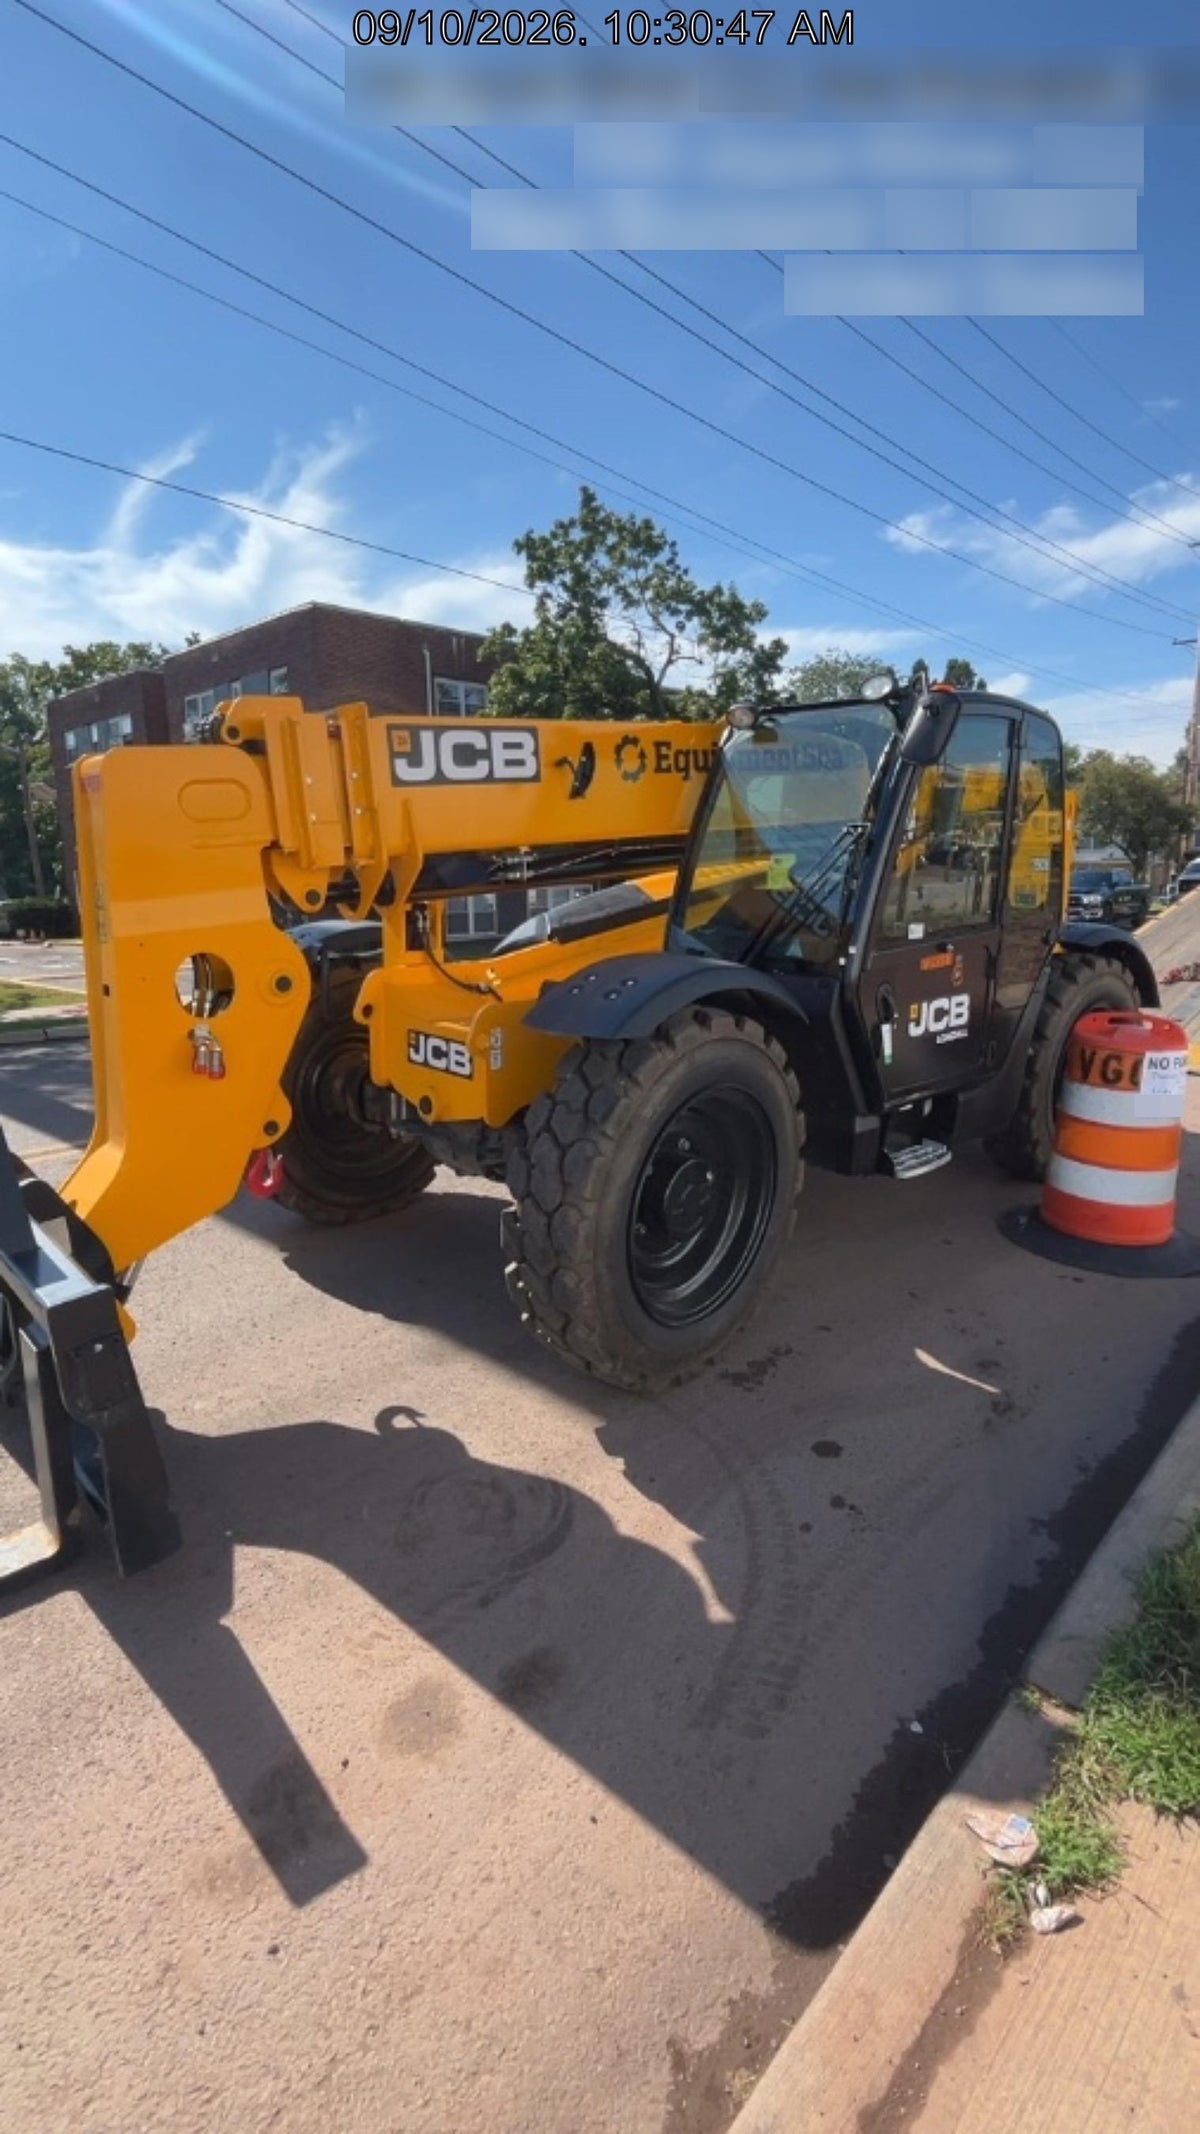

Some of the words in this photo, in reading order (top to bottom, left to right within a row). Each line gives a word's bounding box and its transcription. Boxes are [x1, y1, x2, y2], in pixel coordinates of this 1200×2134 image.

[393, 729, 537, 781] JCB
[908, 993, 970, 1037] JCB
[409, 1032, 471, 1077] JCB
[1147, 1056, 1170, 1070] NO
